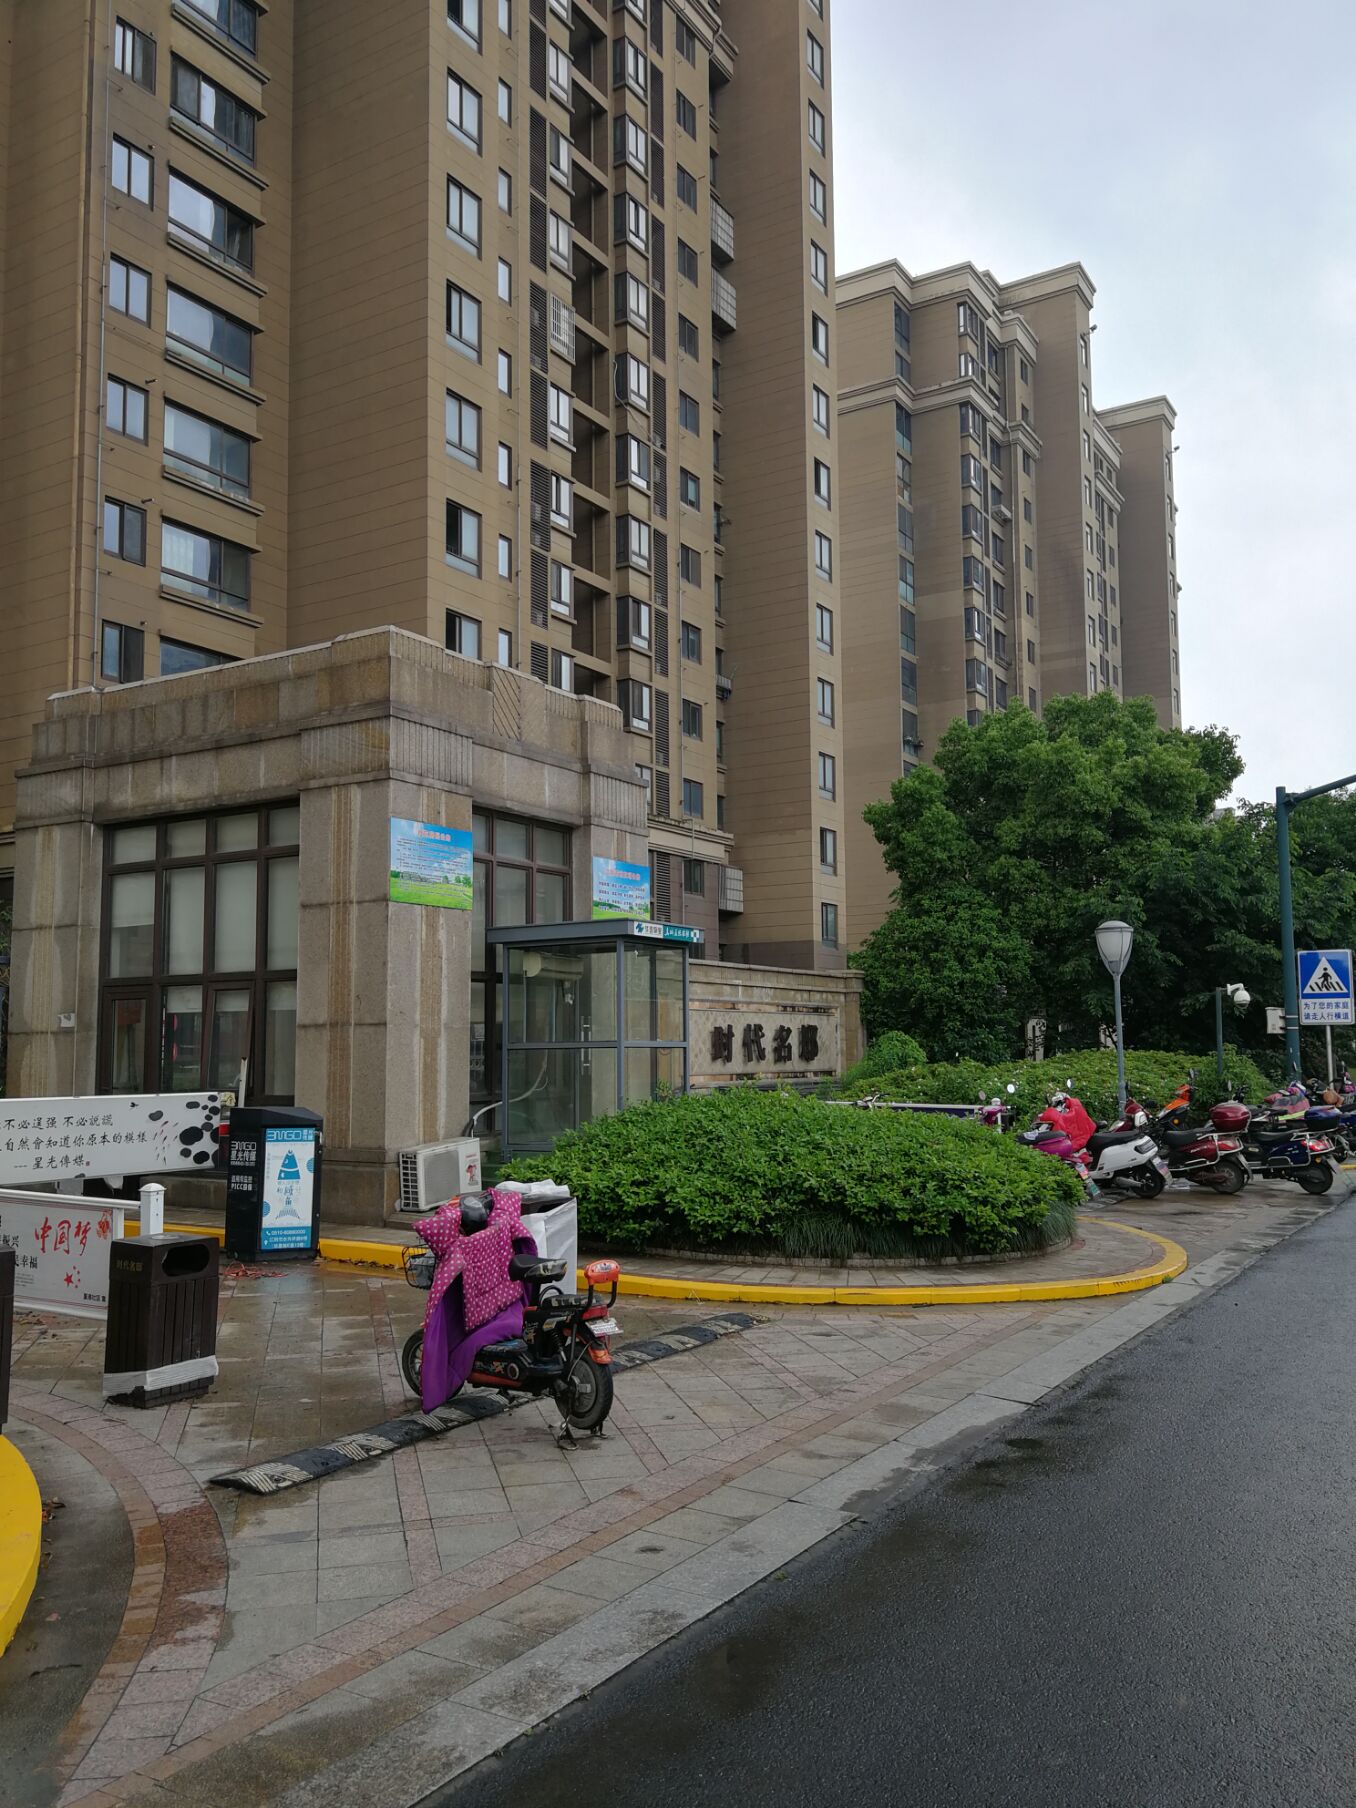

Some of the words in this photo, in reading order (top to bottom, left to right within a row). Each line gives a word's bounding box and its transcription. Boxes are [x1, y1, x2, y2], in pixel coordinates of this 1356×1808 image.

[1303, 1002, 1349, 1010] 为了您的家庭
[1303, 1012, 1350, 1021] 请走人行横道
[0, 1116, 58, 1131] 不必逞强
[0, 1131, 148, 1152] 自然會知道你原本的模樣
[230, 1150, 257, 1162] 星光传媒
[0, 1233, 20, 1248] 振兴
[34, 1216, 91, 1256] 中国梦
